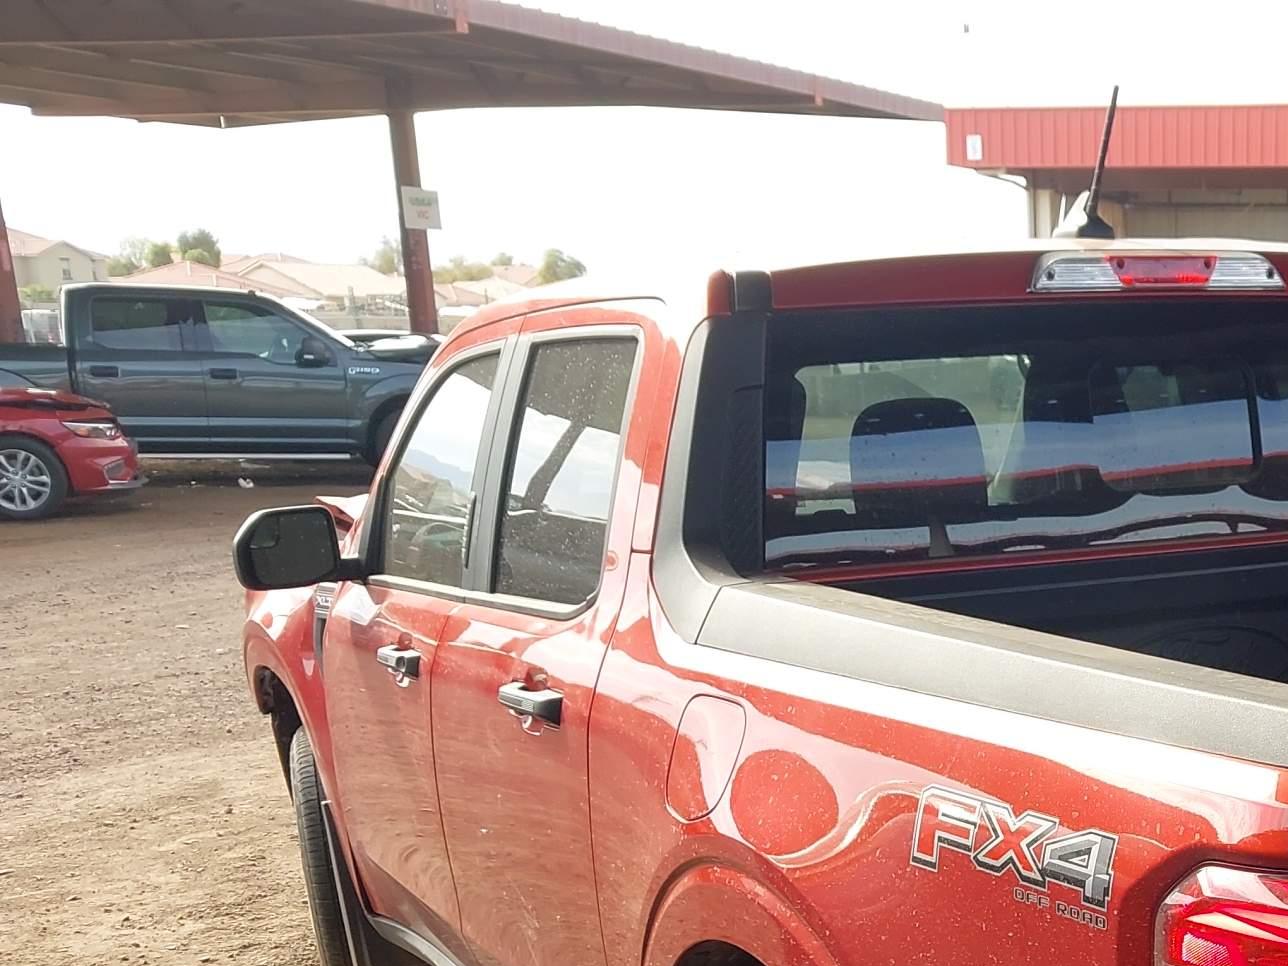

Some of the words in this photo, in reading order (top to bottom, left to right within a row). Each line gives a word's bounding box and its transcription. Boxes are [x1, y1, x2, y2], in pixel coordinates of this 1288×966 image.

[910, 784, 1119, 912] FX4
[1014, 888, 1050, 910] OFF
[1056, 900, 1108, 930] ROAD
